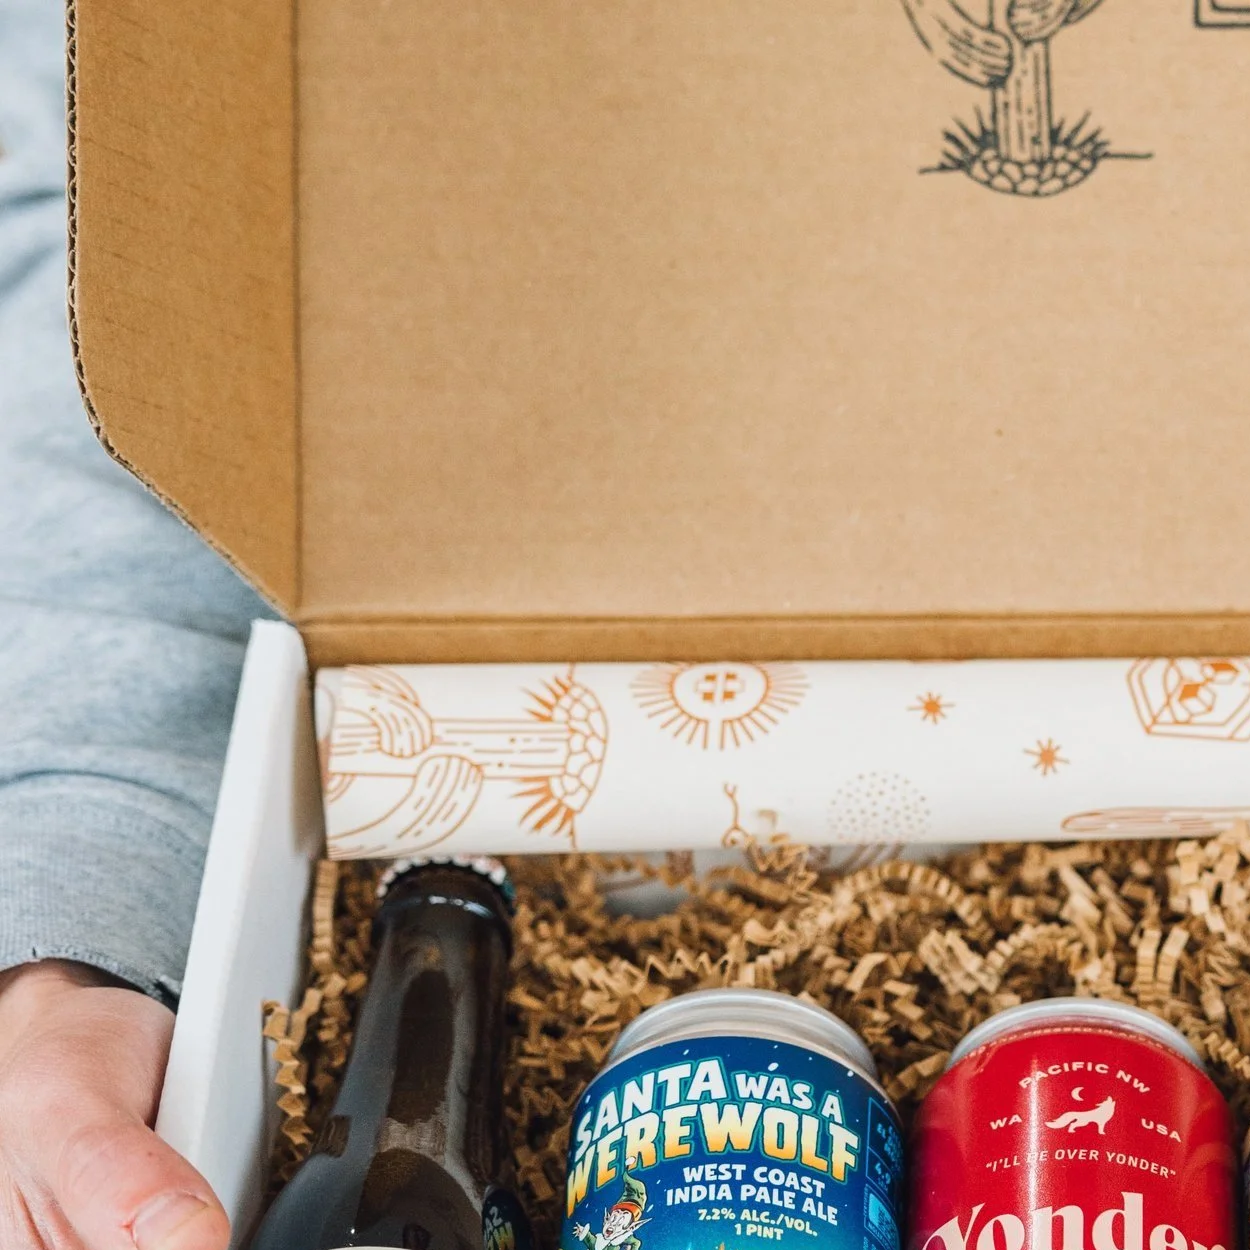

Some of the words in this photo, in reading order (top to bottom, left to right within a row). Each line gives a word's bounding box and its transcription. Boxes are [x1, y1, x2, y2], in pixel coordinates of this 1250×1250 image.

[1019, 1062, 1109, 1088] PACIFIC
[1116, 1070, 1150, 1093] NW
[574, 1058, 728, 1163] SANTA
[734, 1072, 814, 1111] WAS
[820, 1093, 844, 1125] A
[990, 1114, 1022, 1130] WA
[1141, 1117, 1182, 1143] USA
[566, 1102, 859, 1219] WEREWOLF
[1054, 1149, 1099, 1161] OVER
[683, 1163, 746, 1184] WEST
[753, 1166, 826, 1199] COAST
[666, 1183, 733, 1206] INDIA
[740, 1184, 796, 1210] PALE
[801, 1198, 838, 1226] ALE
[698, 1207, 736, 1221] 7.2%
[740, 1208, 818, 1237] ALC./VOL.
[734, 1223, 742, 1236] 1
[746, 1223, 784, 1241] PINT
